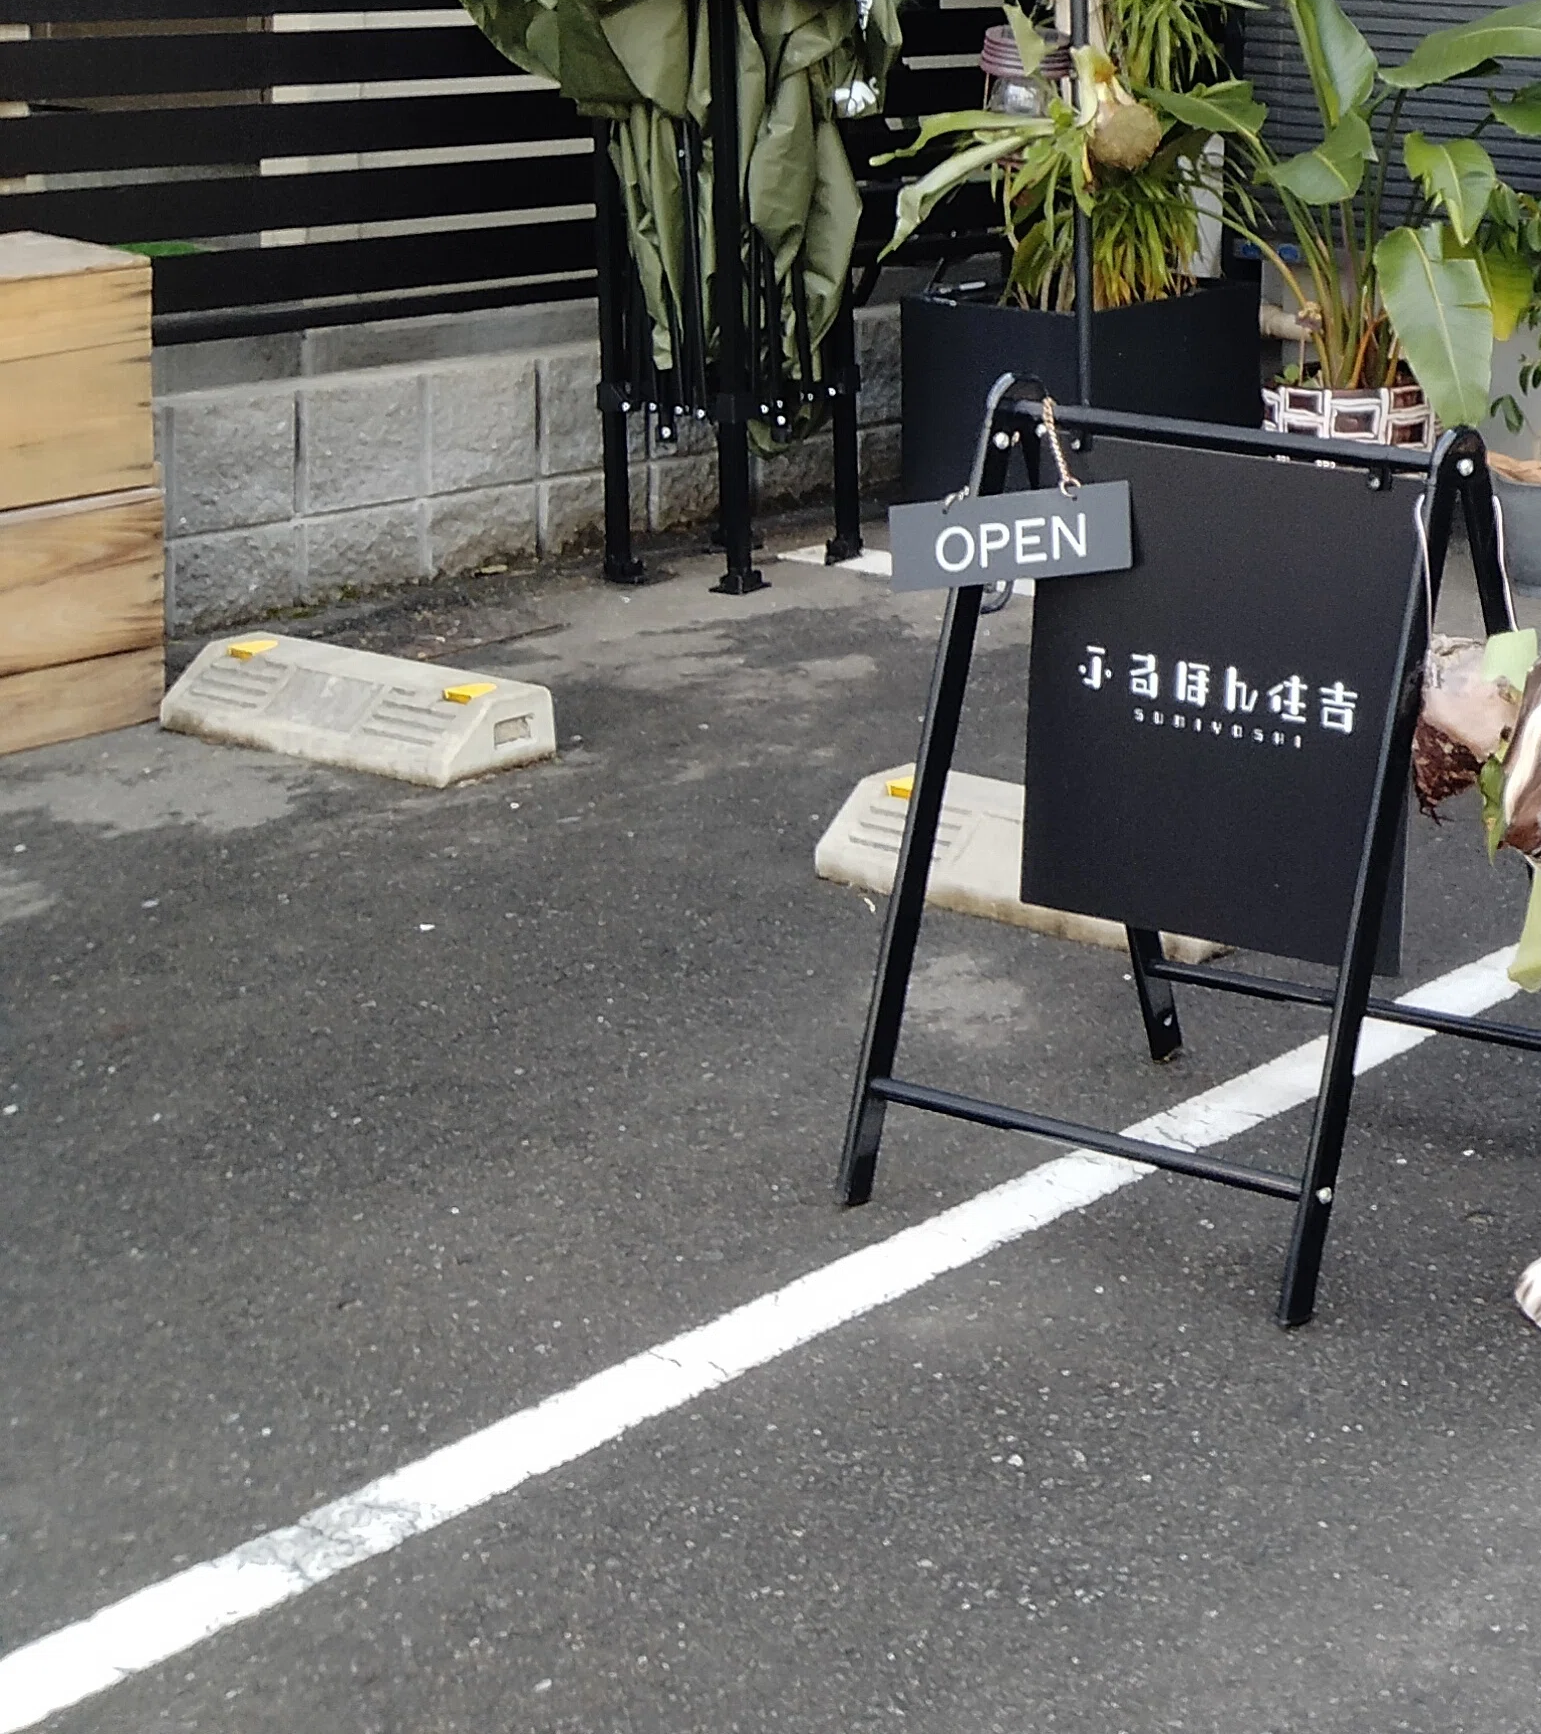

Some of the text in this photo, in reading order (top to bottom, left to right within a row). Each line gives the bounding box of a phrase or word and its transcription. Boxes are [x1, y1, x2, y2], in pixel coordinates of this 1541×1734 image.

[934, 512, 1088, 573] OPEN
[1077, 644, 1360, 735] ふるほん住吉
[1133, 707, 1303, 750] SUMIYOSHI
